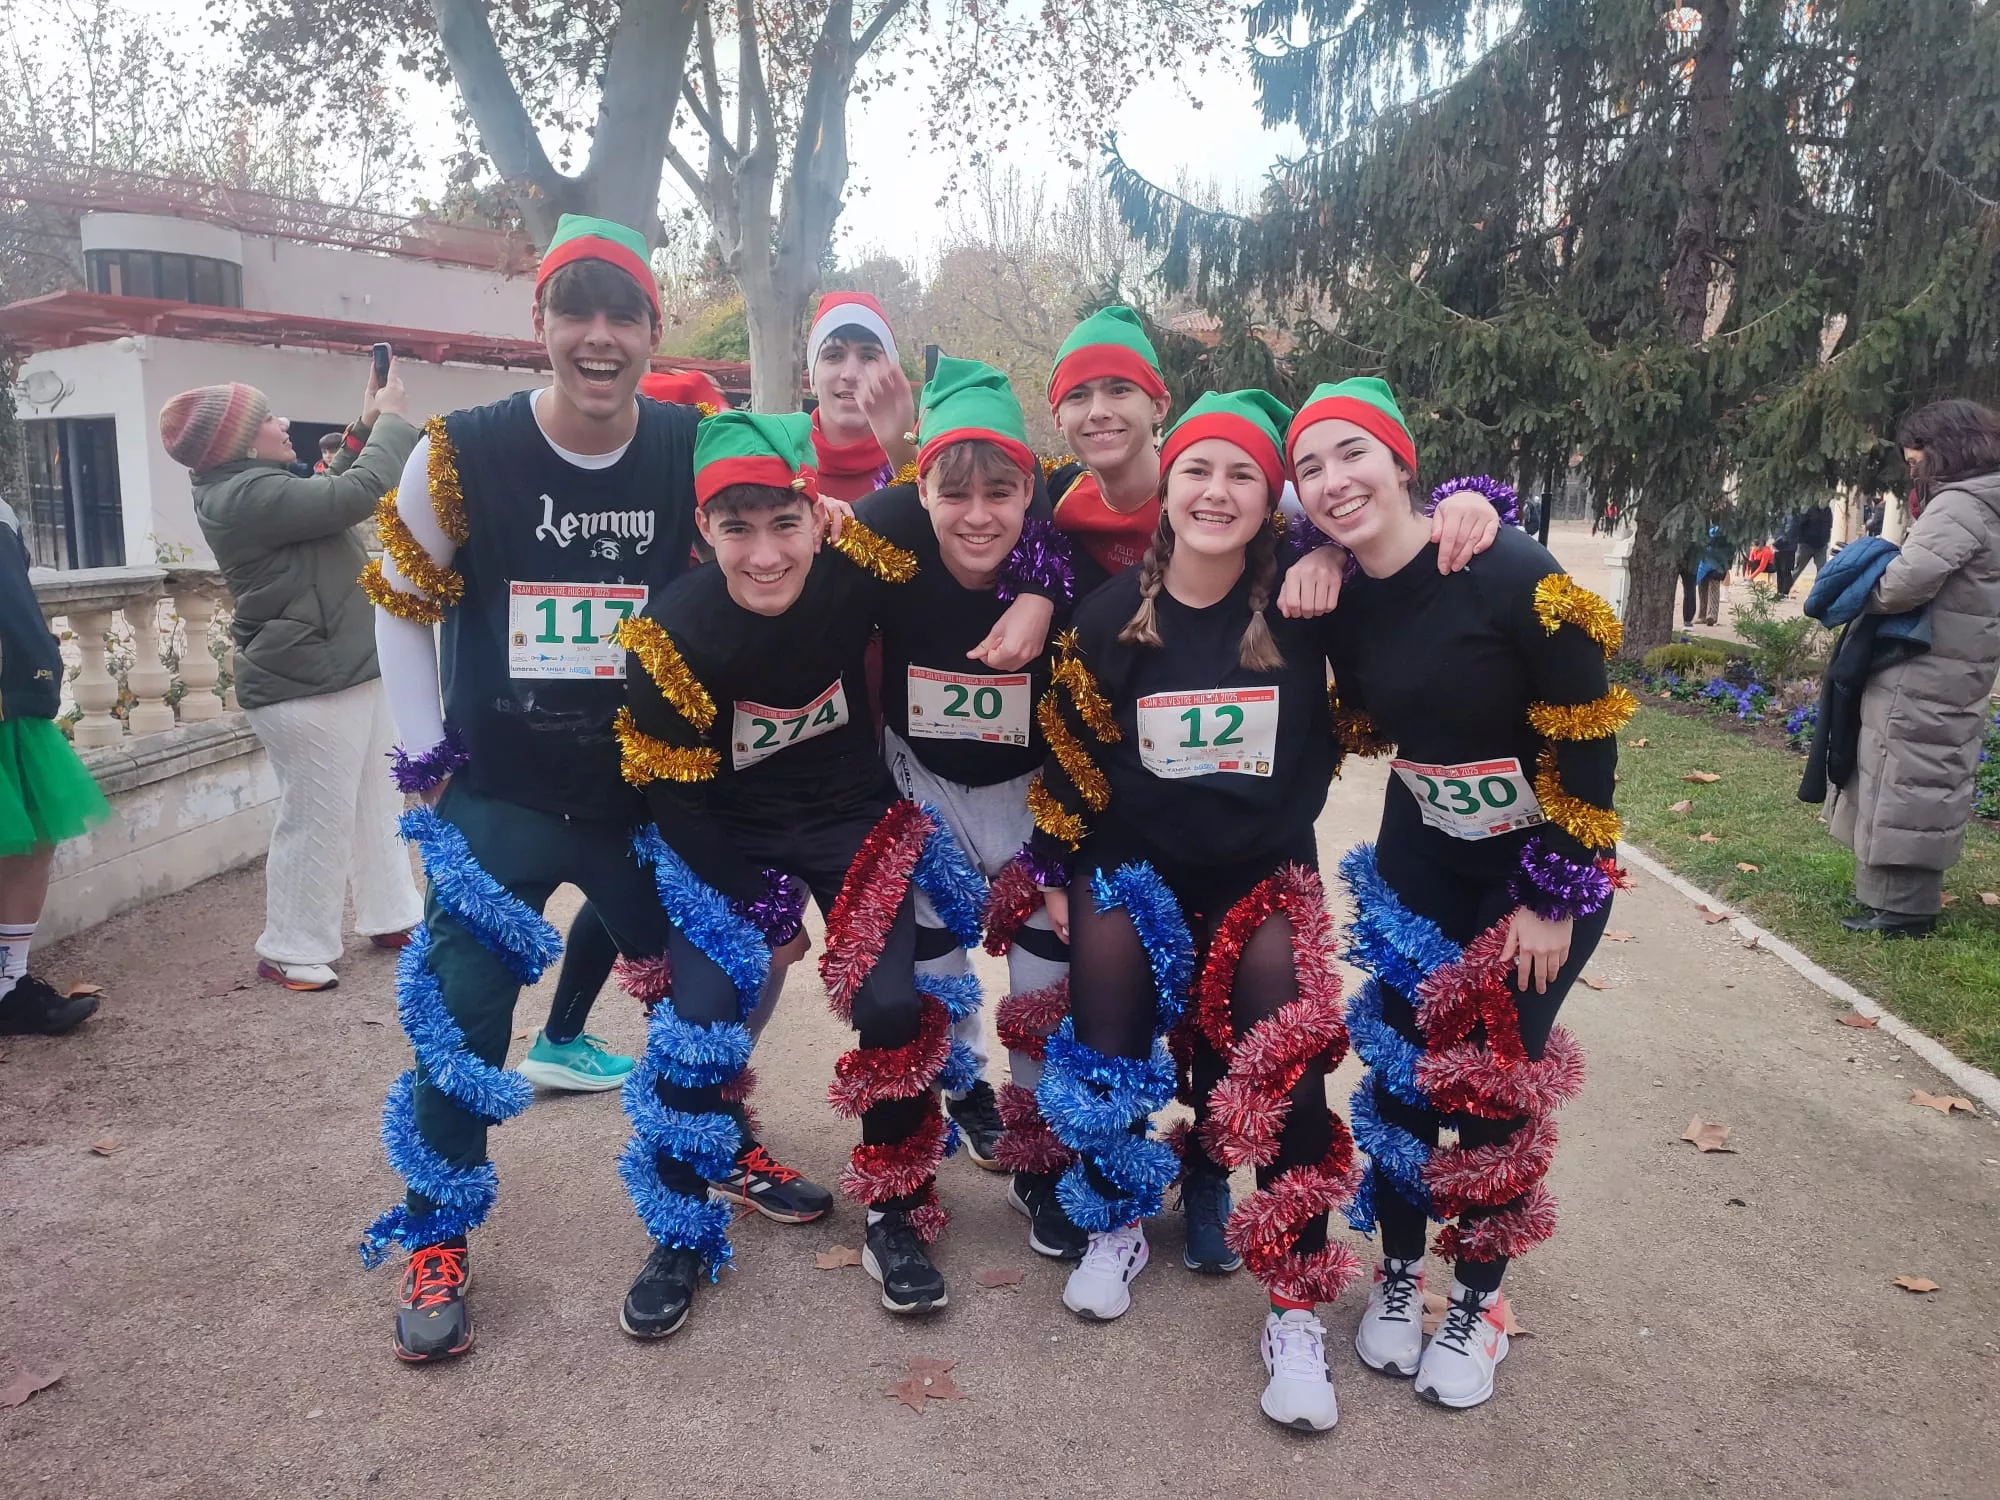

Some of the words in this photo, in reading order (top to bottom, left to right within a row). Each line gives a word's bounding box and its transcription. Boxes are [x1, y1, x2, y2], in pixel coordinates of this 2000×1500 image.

[535, 493, 655, 555] Lemmy
[516, 585, 531, 595] SAN
[532, 586, 566, 596] SILVESTRE
[567, 587, 593, 597] HUESCA
[594, 588, 611, 597] 2025
[535, 598, 634, 644] 117
[943, 684, 1003, 719] 20
[1144, 698, 1158, 707] SAN
[1158, 696, 1193, 706] SILVESTRE
[1220, 692, 1238, 703] 2025
[752, 699, 839, 749] 274
[1180, 705, 1244, 747] 12
[1461, 767, 1479, 776] 2025
[1415, 775, 1518, 815] 230
